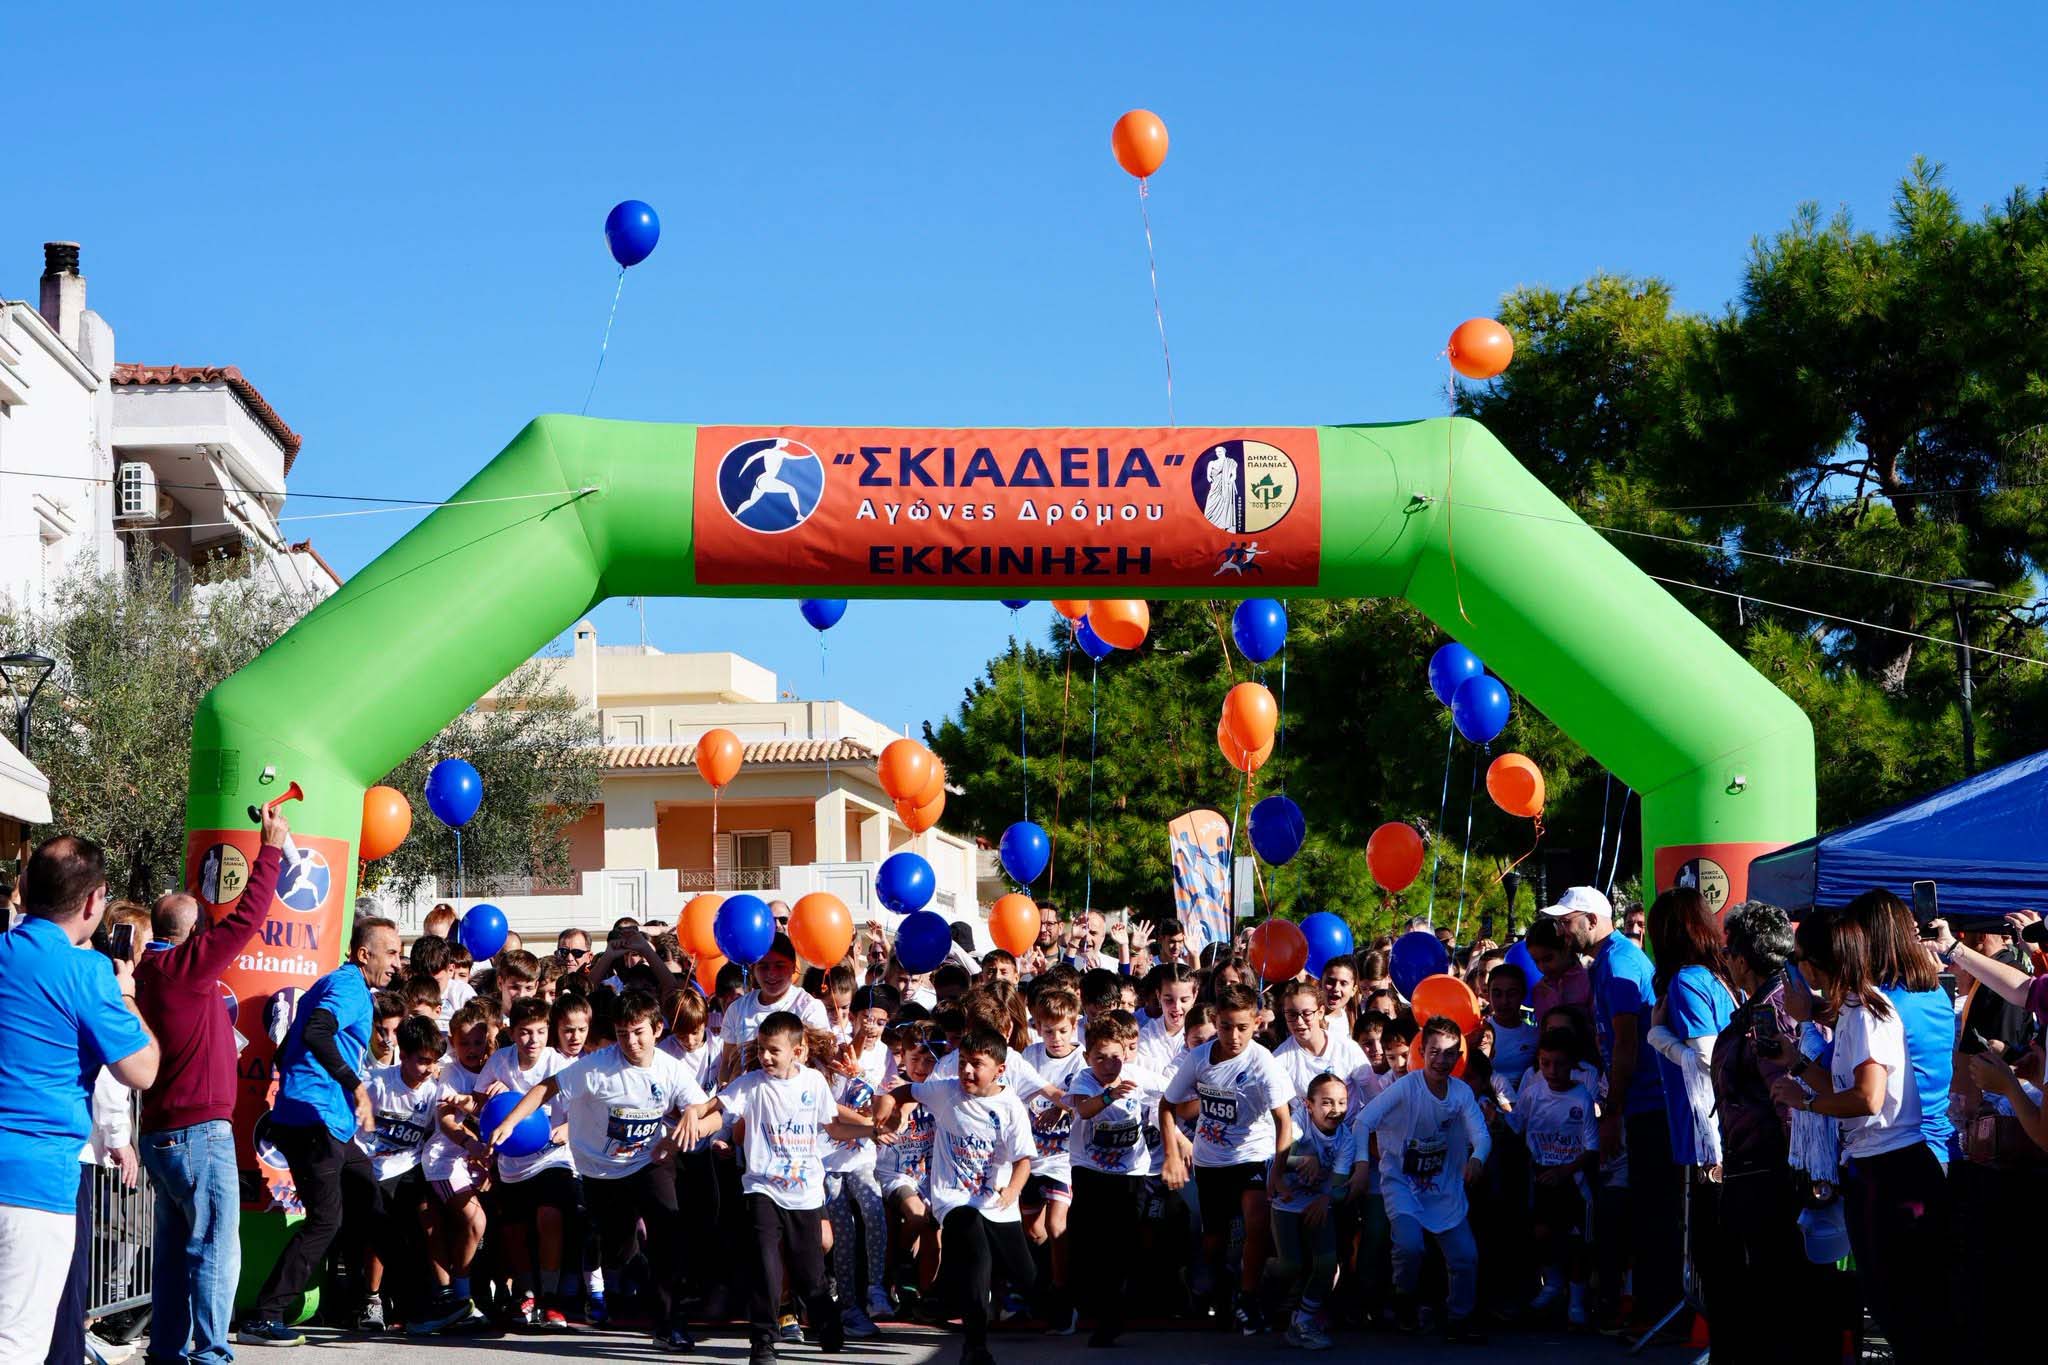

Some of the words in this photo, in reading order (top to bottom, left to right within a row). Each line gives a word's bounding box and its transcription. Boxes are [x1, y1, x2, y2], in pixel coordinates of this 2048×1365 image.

[1247, 461, 1289, 469] ΠΑΙΑΝΙΑΣ
[855, 498, 997, 526] Αγώνες
[1017, 498, 1165, 527] Δρόμου
[869, 546, 1153, 576] ΕΚΚΙΝΗΣΗ
[265, 920, 321, 951] RUN
[228, 951, 318, 976] aiania
[1202, 1099, 1236, 1120] 1458
[388, 1123, 421, 1143] 1360
[626, 1121, 659, 1138] 1489
